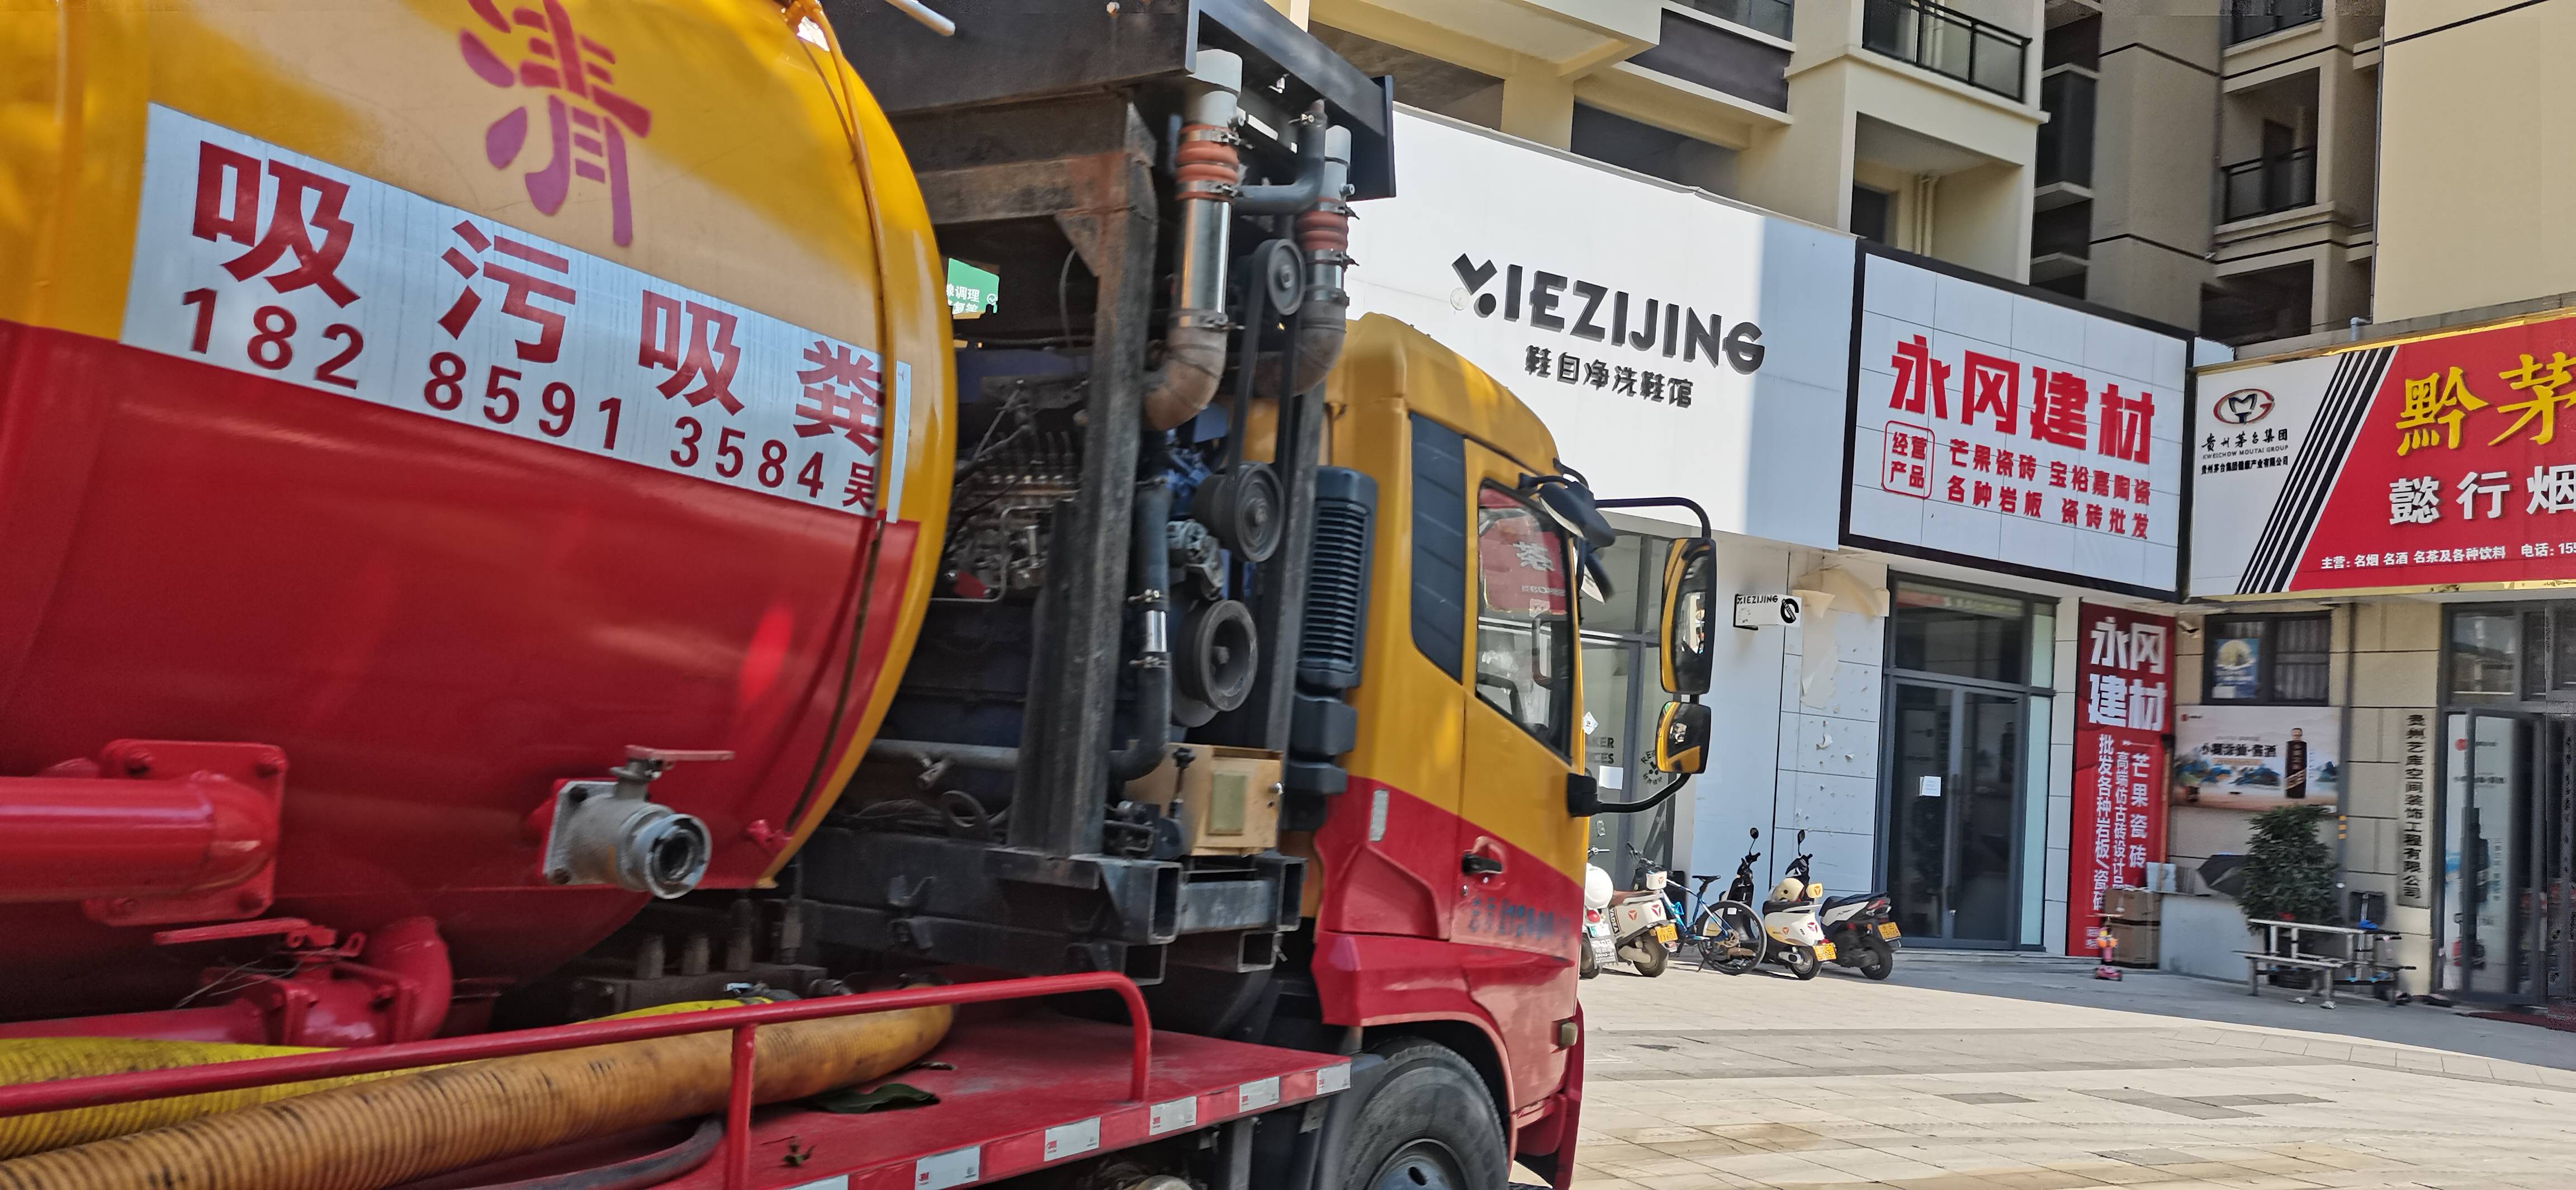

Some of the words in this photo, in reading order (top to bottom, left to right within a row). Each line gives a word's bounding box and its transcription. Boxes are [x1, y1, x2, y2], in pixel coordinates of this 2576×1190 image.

[183, 287, 364, 390] 182
[424, 352, 622, 450] 8591
[671, 416, 825, 498] 3584
[1889, 334, 2155, 465] 永冈建材
[1891, 431, 1928, 461] 经营
[2201, 428, 2288, 452] 贵州茅台集团
[2203, 450, 2237, 460] KWEICHOW
[2266, 445, 2289, 453] GROUP
[1889, 461, 1925, 489] 产品
[1949, 438, 2037, 483] 芒果瓷砖
[2048, 461, 2151, 506] 宝裕嘉陶瓷
[1947, 475, 2043, 519] 各种岩板
[2061, 498, 2149, 540] 瓷砖批发
[2090, 617, 2167, 674] 永冈
[2088, 673, 2166, 731] 建材
